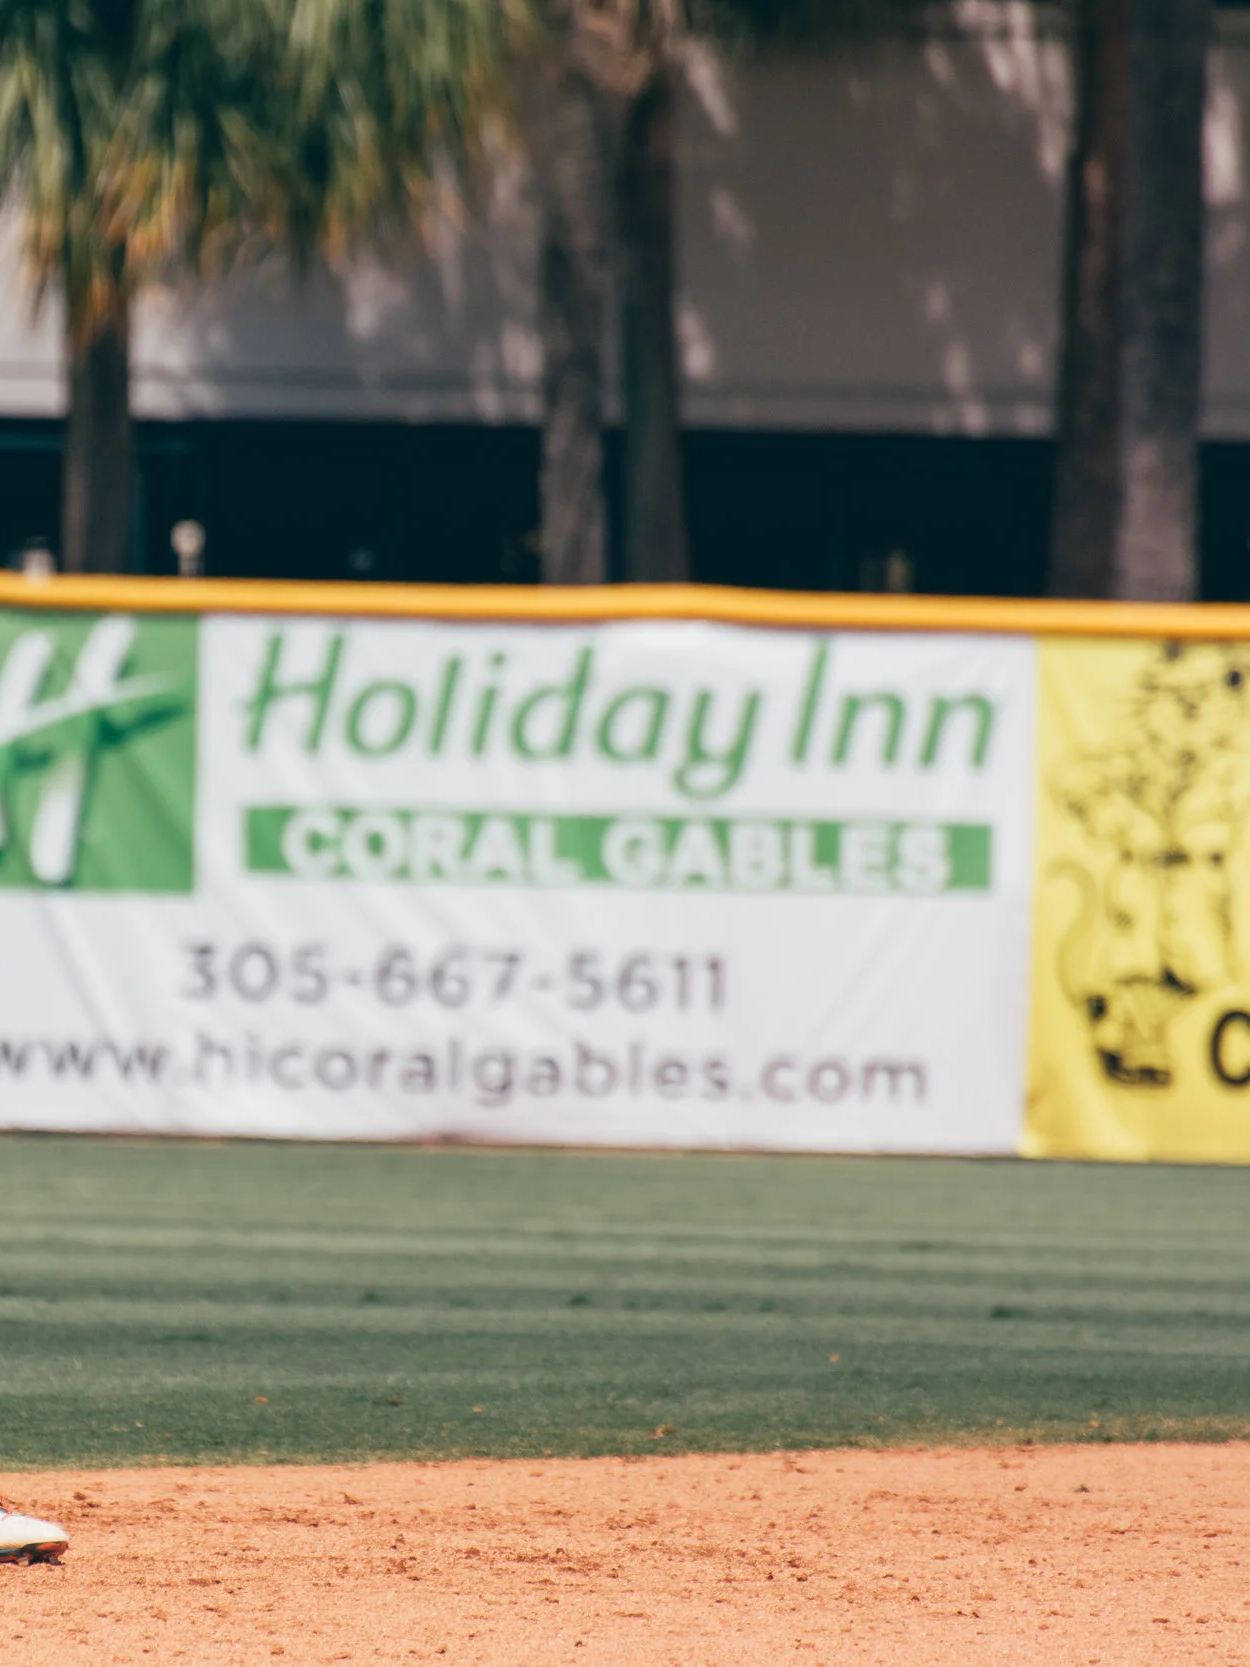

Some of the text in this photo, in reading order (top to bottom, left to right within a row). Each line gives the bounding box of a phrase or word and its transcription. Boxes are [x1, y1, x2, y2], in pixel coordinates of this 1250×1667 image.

[246, 632, 996, 799] Holiday Inn
[281, 807, 953, 891] CORAL GABLES
[182, 942, 728, 1014] 305-667-5611
